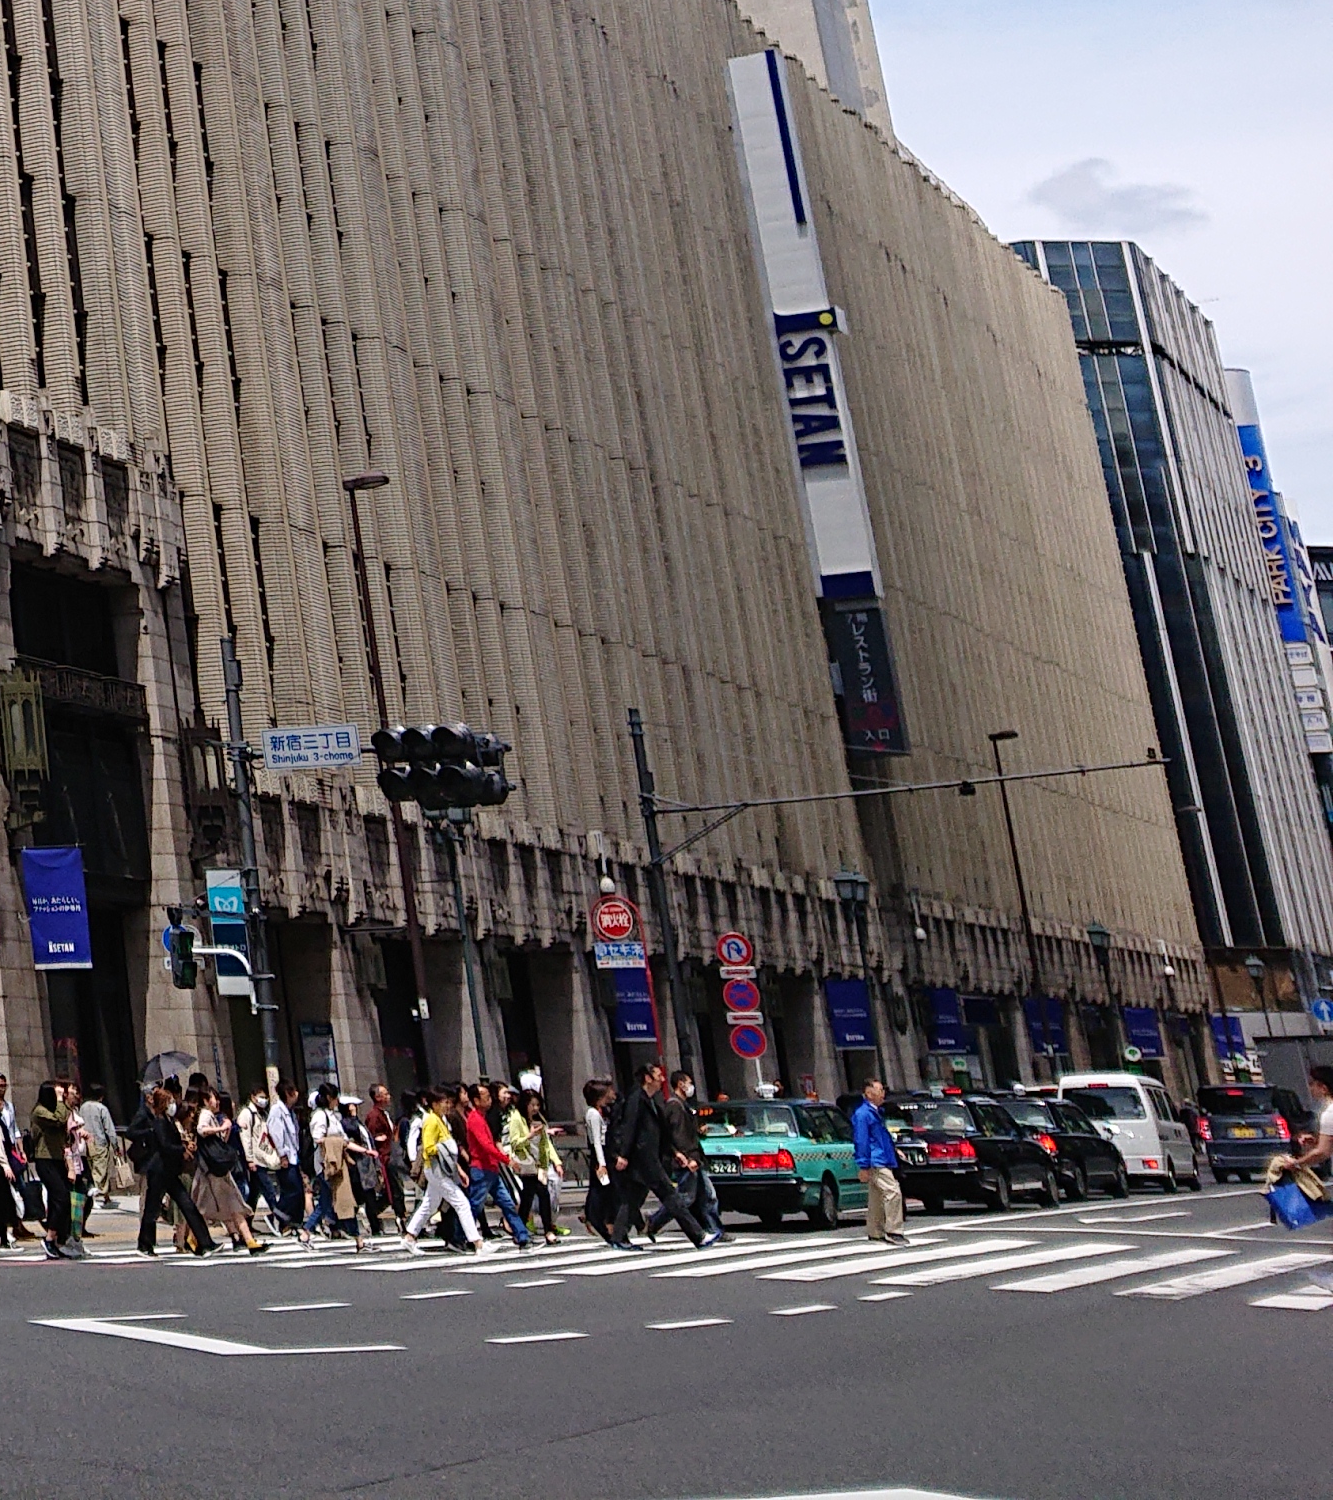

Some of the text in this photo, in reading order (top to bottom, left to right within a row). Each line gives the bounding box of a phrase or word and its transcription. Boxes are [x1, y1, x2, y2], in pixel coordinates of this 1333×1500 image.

[773, 306, 849, 468] ISETAN
[270, 732, 351, 751] 新宿三丁目
[272, 751, 353, 764] Shinjuku 3-chome
[48, 941, 75, 953] ISETAN
